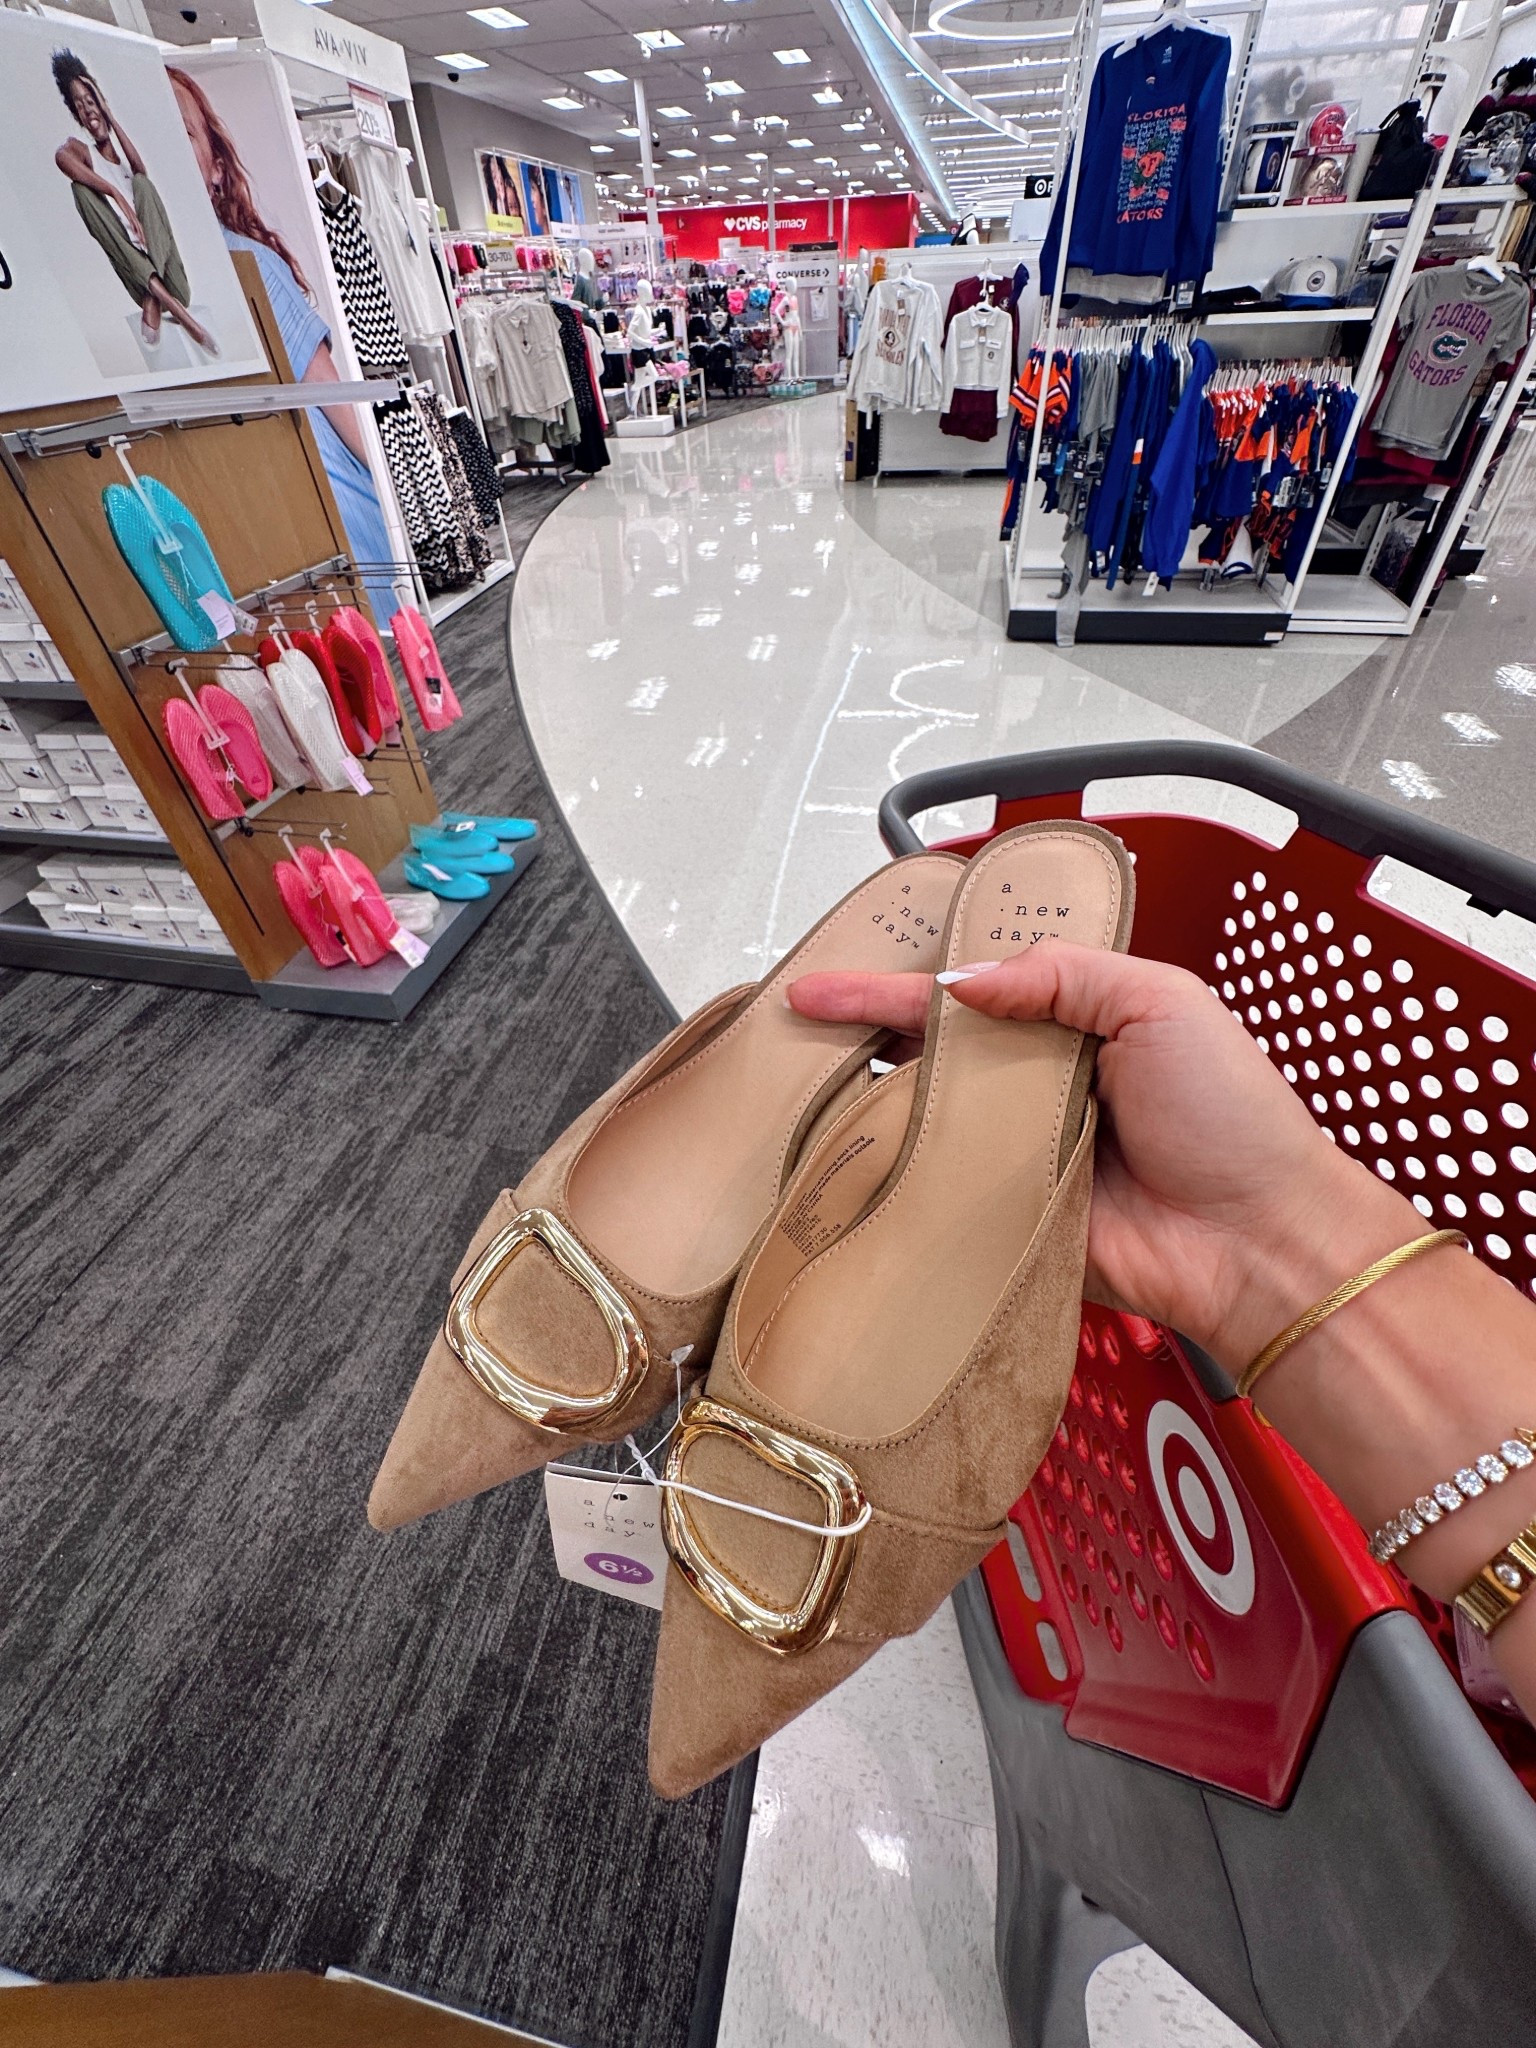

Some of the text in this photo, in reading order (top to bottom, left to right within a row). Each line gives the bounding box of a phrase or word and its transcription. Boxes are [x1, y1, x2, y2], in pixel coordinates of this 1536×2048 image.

[314, 27, 340, 57] AVA
[343, 38, 367, 66] VIV
[1127, 103, 1186, 122] FLORIDA
[736, 215, 808, 232] CVS parmacy
[776, 268, 821, 280] CONVERSE
[1426, 302, 1493, 345] FLORIDA
[1408, 350, 1468, 387] GATORS
[901, 885, 911, 895] a
[1001, 883, 1013, 894] a
[1014, 905, 1071, 918] new
[899, 906, 940, 937] new
[830, 1153, 855, 1177] materials
[854, 1137, 876, 1155] outsole
[583, 1499, 595, 1507] a
[605, 1513, 655, 1529] new
